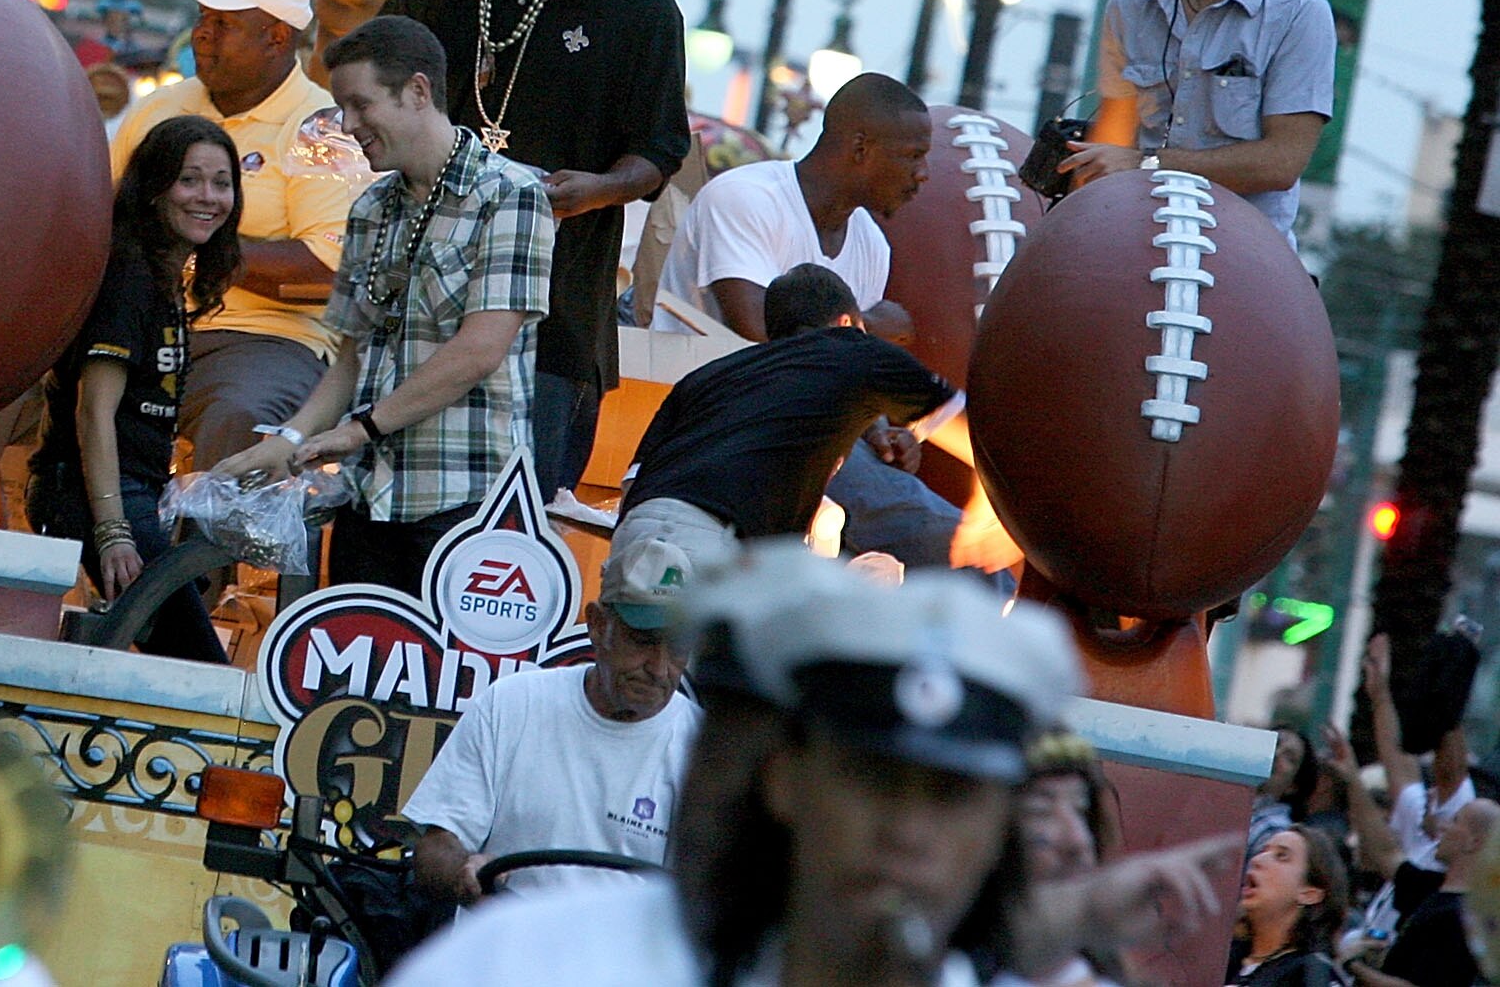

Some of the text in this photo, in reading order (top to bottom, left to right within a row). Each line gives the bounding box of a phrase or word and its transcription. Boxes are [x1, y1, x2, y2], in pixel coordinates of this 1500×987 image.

[463, 559, 537, 603] EA
[460, 595, 537, 621] SPORTS
[302, 628, 541, 712] MAD
[607, 812, 643, 829] BLAINE
